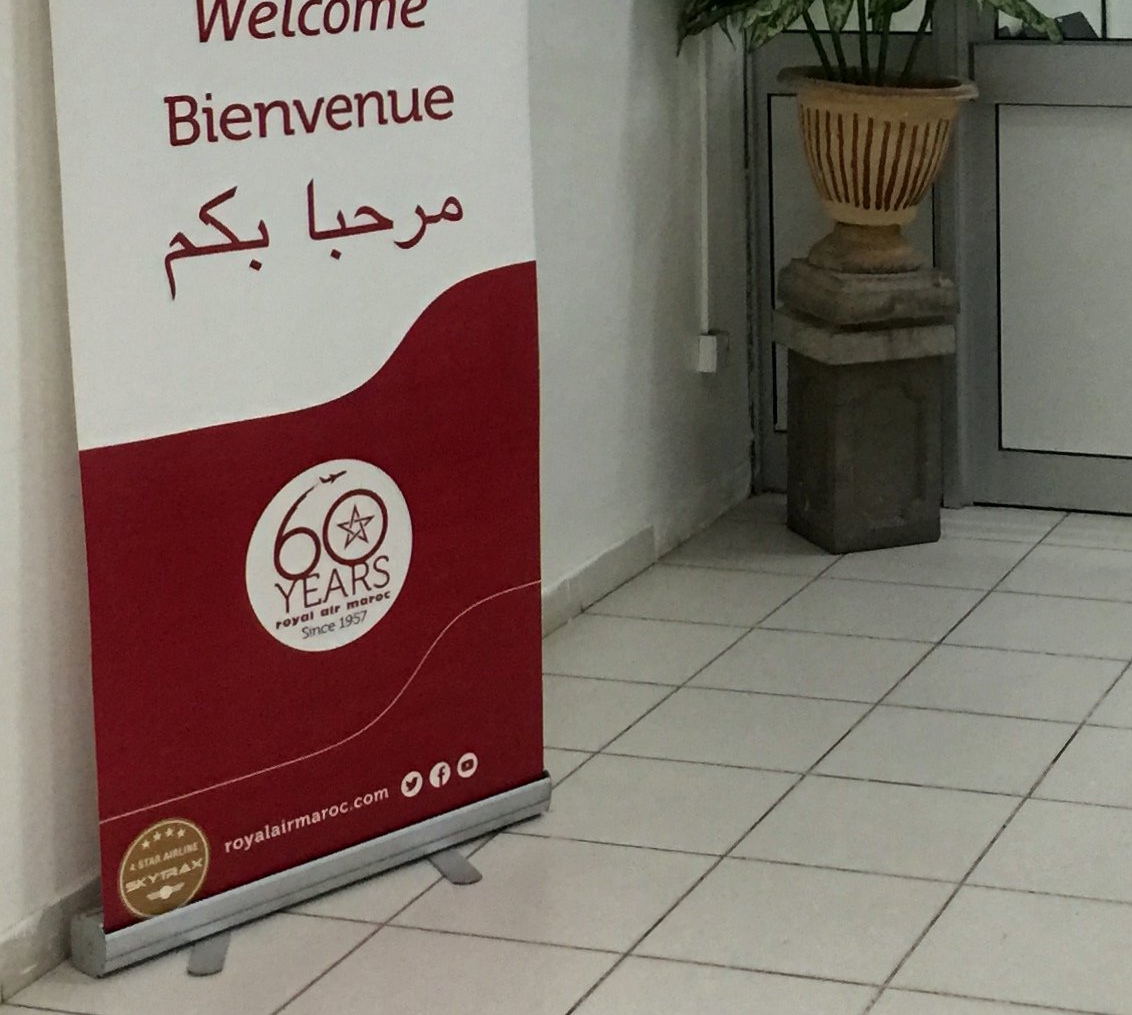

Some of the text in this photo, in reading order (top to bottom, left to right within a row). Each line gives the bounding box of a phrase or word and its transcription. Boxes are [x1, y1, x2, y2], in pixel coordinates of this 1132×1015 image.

[163, 84, 455, 147] Bienvenue
[164, 178, 464, 302] مرحبا بكم
[273, 486, 389, 581] 60
[274, 555, 391, 614] YEARS
[275, 591, 391, 630] royal air maroc
[301, 610, 368, 640] Since 1957
[224, 786, 390, 854] royalairmaroc.com
[138, 854, 161, 869] STAR
[163, 842, 198, 861] AIRLINE
